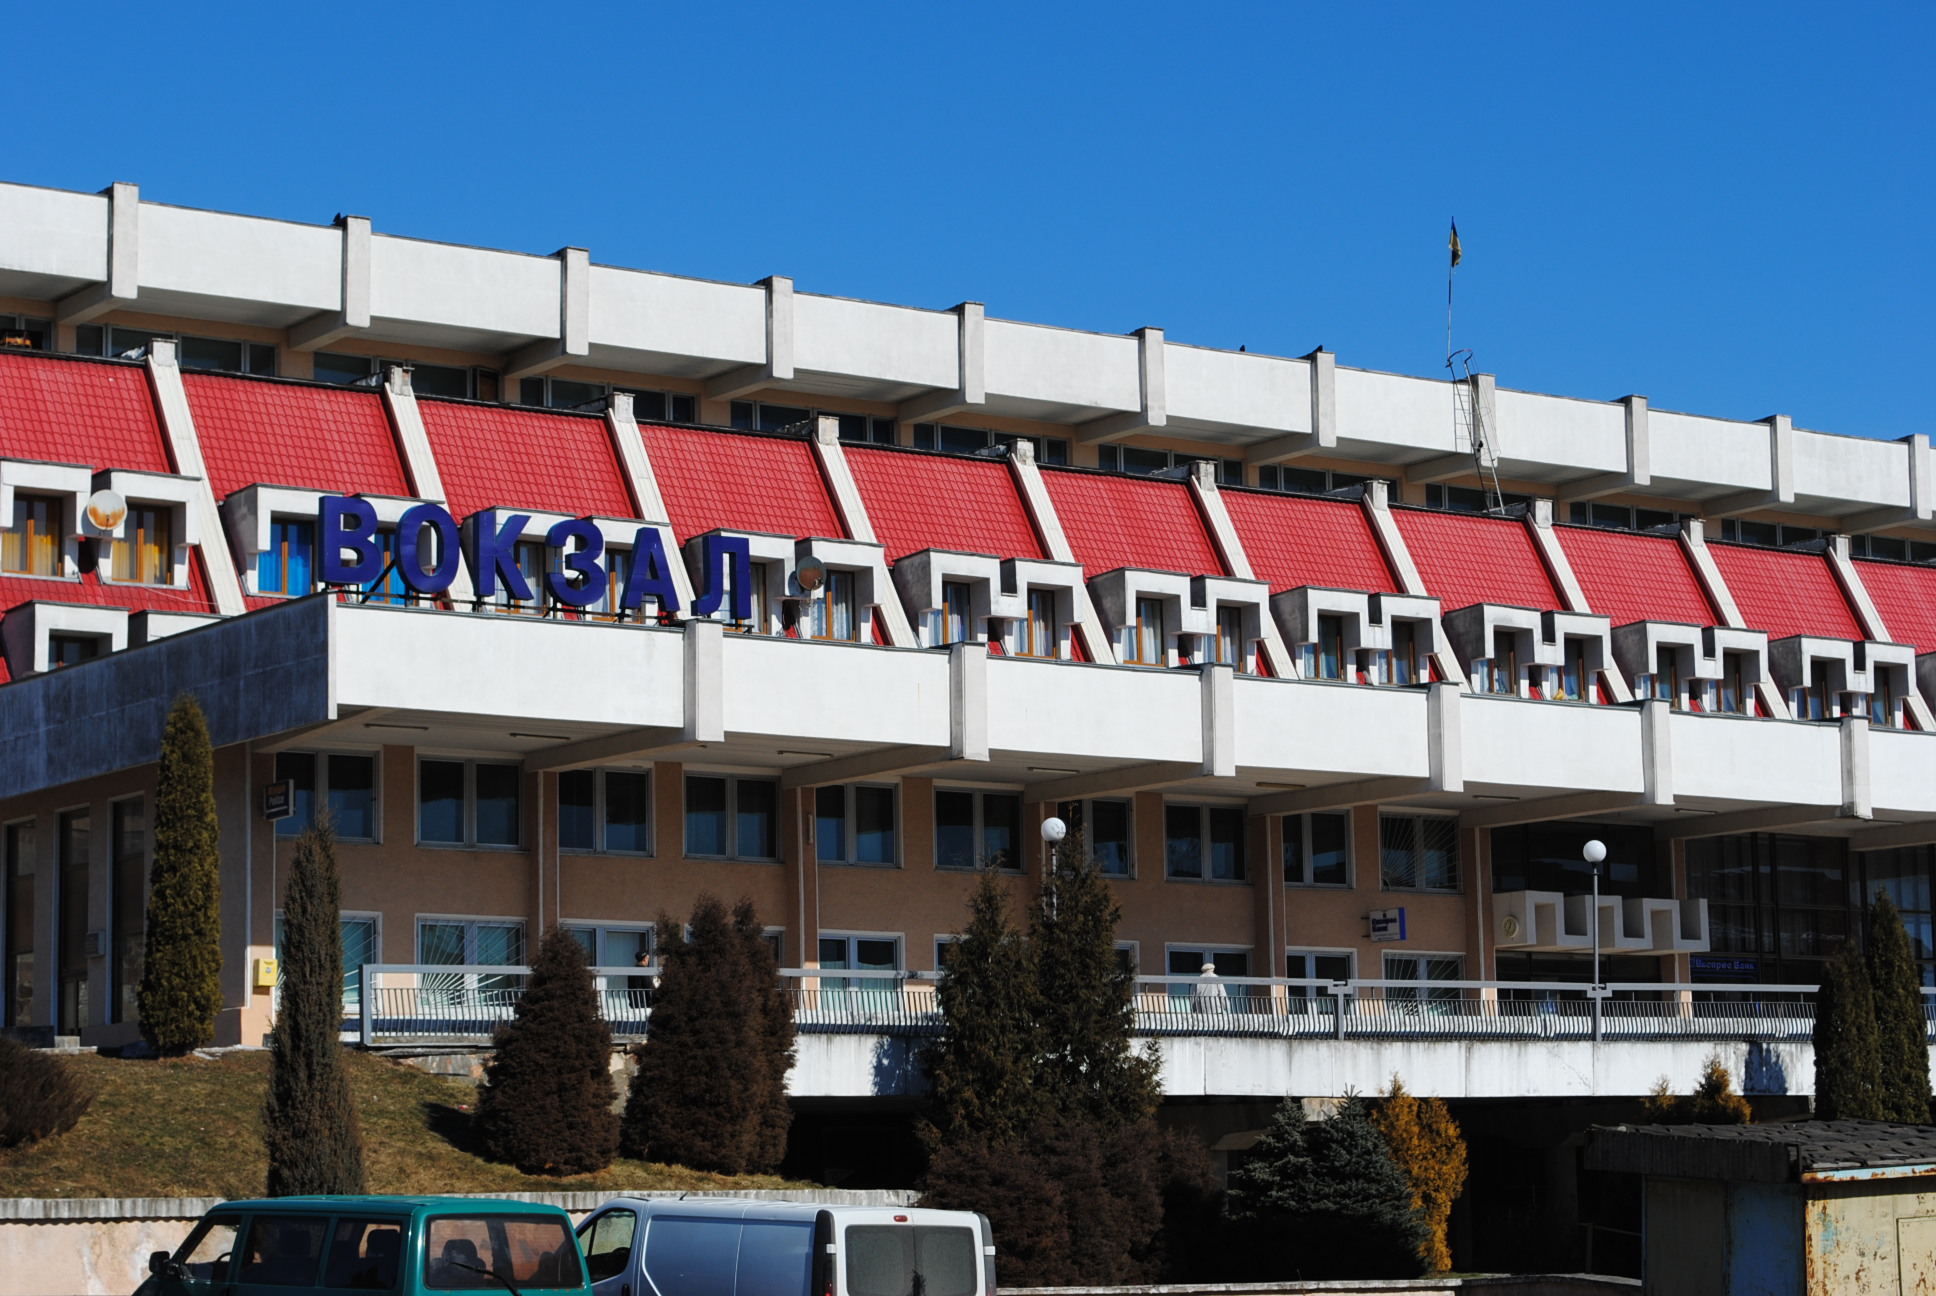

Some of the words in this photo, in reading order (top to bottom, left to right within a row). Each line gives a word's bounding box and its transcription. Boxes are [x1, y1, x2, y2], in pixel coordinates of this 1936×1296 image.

[319, 496, 751, 619] ВОКЗАЛ
[1696, 959, 1732, 971] Експрес
[1733, 959, 1755, 970] Банк
